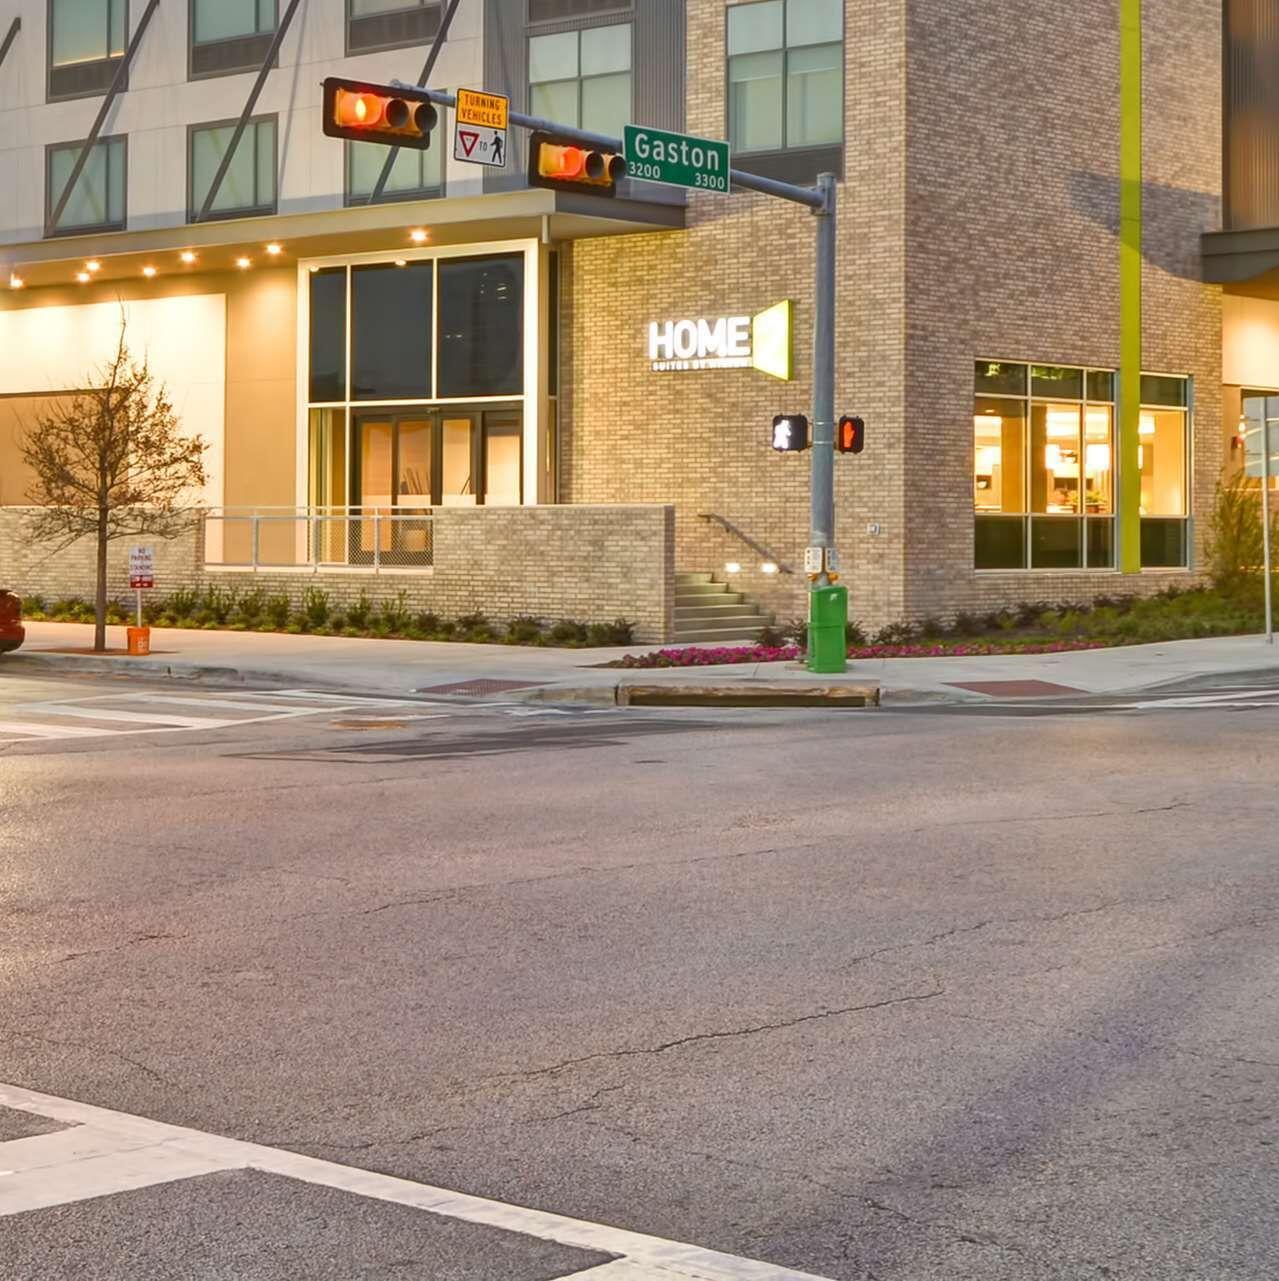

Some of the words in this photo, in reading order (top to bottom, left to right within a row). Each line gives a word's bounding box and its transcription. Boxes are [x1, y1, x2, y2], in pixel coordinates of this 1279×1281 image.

[464, 94, 500, 111] TURNING
[461, 108, 502, 125] VEHICLES
[479, 141, 487, 152] TO
[635, 133, 719, 171] Gaston
[629, 161, 661, 179] 3200
[695, 173, 725, 189] 3300
